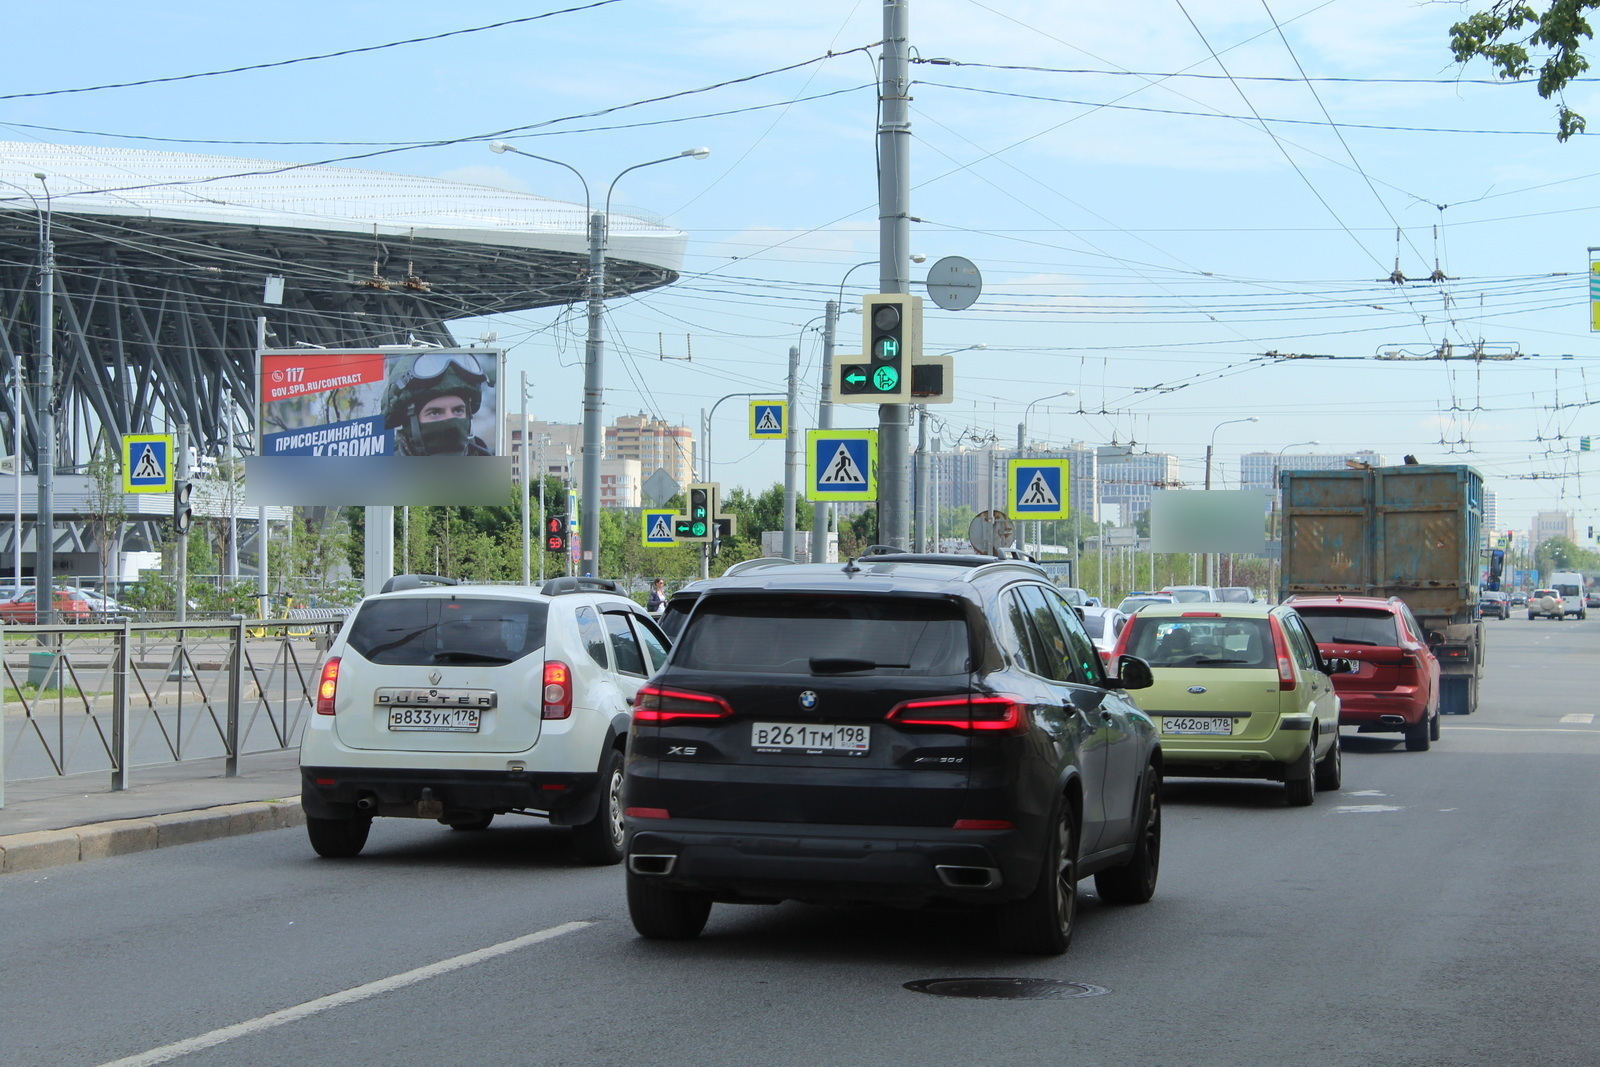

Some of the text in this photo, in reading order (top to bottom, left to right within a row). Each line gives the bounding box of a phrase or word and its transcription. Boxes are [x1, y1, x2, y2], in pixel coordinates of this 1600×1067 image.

[884, 341, 896, 356] 14
[286, 367, 305, 382] 117
[272, 373, 362, 397] GOV.SPB.RU/CONTRACT
[276, 421, 373, 452] ПРИСОЕДИНЯЙСЯ
[379, 695, 490, 705] DUSTER
[394, 710, 475, 725] В833УК 178
[1212, 718, 1229, 727] 178
[758, 726, 864, 747] В261ТМ 198
[667, 746, 698, 755] X5
